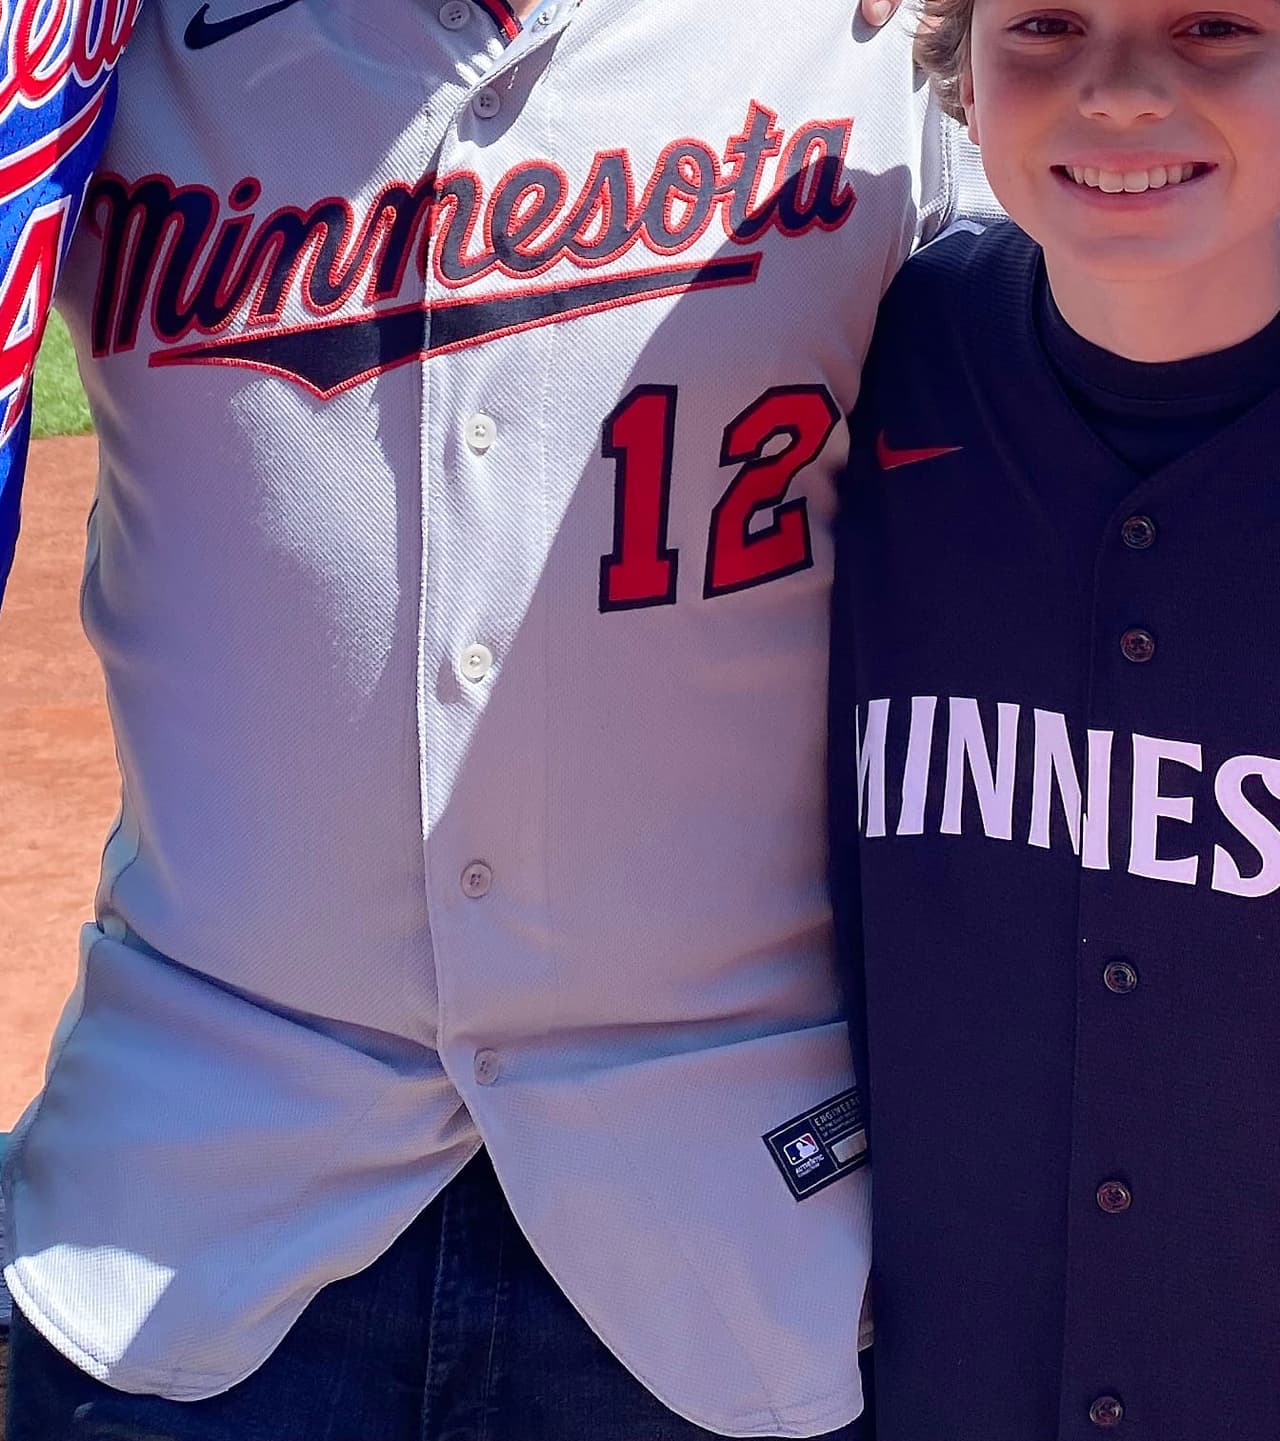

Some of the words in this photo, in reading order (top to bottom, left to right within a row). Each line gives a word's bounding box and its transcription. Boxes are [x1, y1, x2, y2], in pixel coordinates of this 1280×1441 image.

[89, 100, 856, 358] Minnesota
[598, 383, 842, 613] 12
[814, 1097, 861, 1127] ENGINEER
